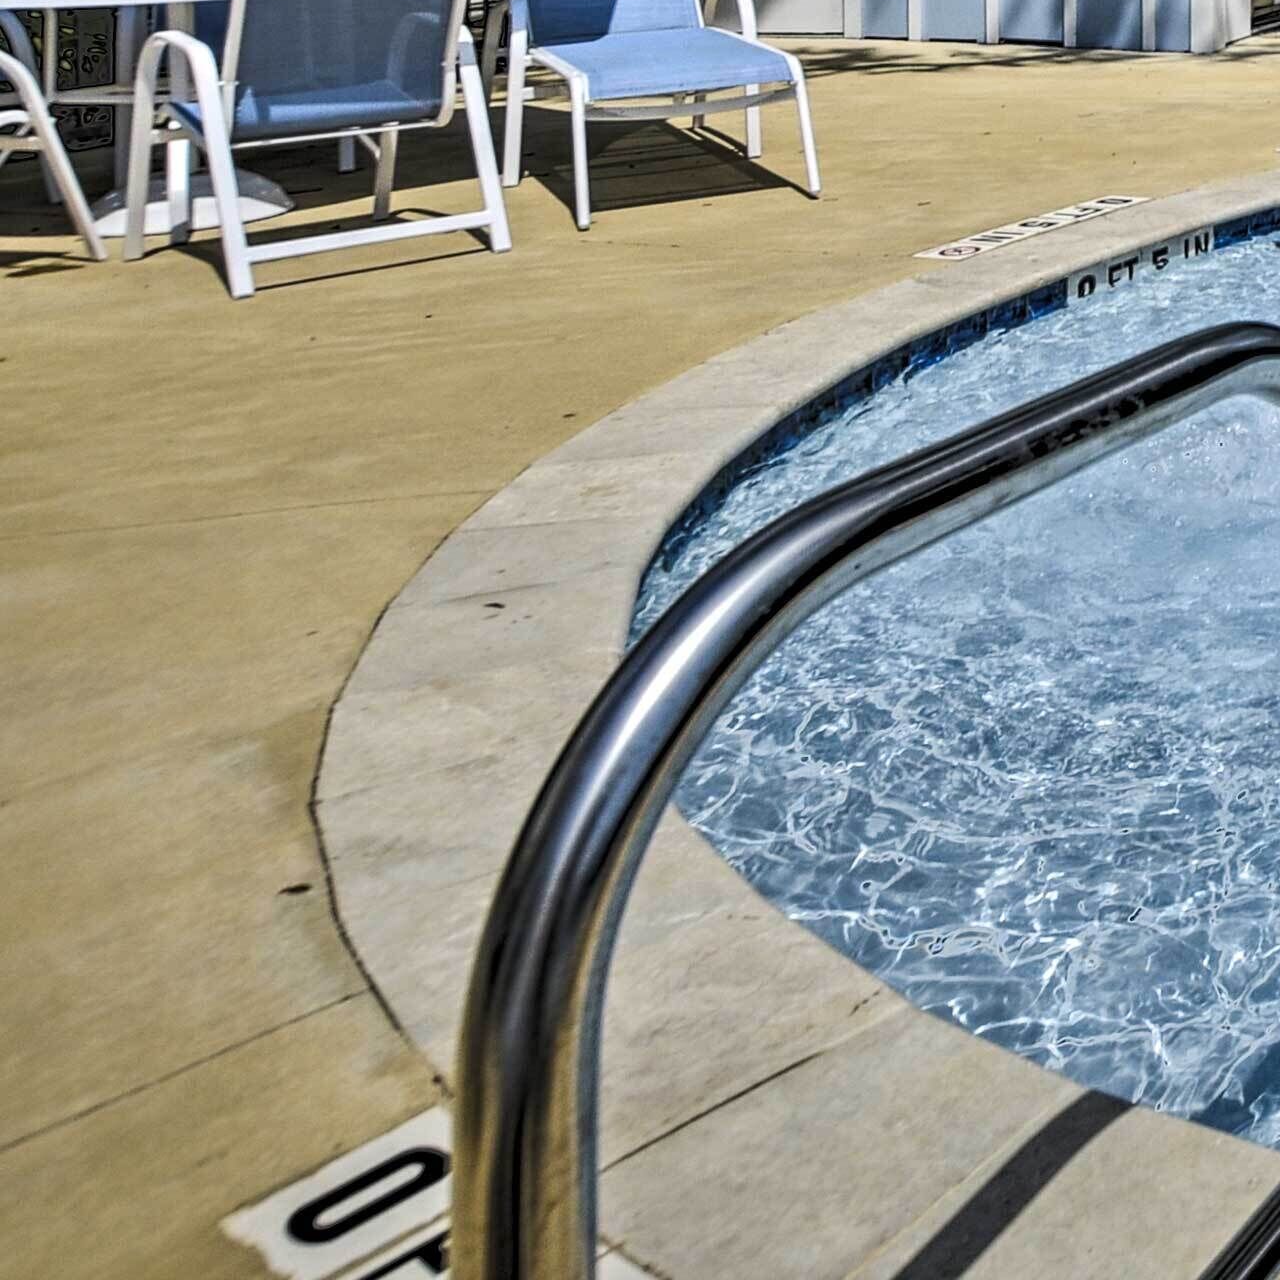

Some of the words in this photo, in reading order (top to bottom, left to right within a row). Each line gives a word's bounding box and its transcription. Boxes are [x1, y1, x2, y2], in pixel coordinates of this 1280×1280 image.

[1108, 256, 1140, 288] FT
[1152, 246, 1169, 270] 5
[1184, 232, 1209, 259] IN
